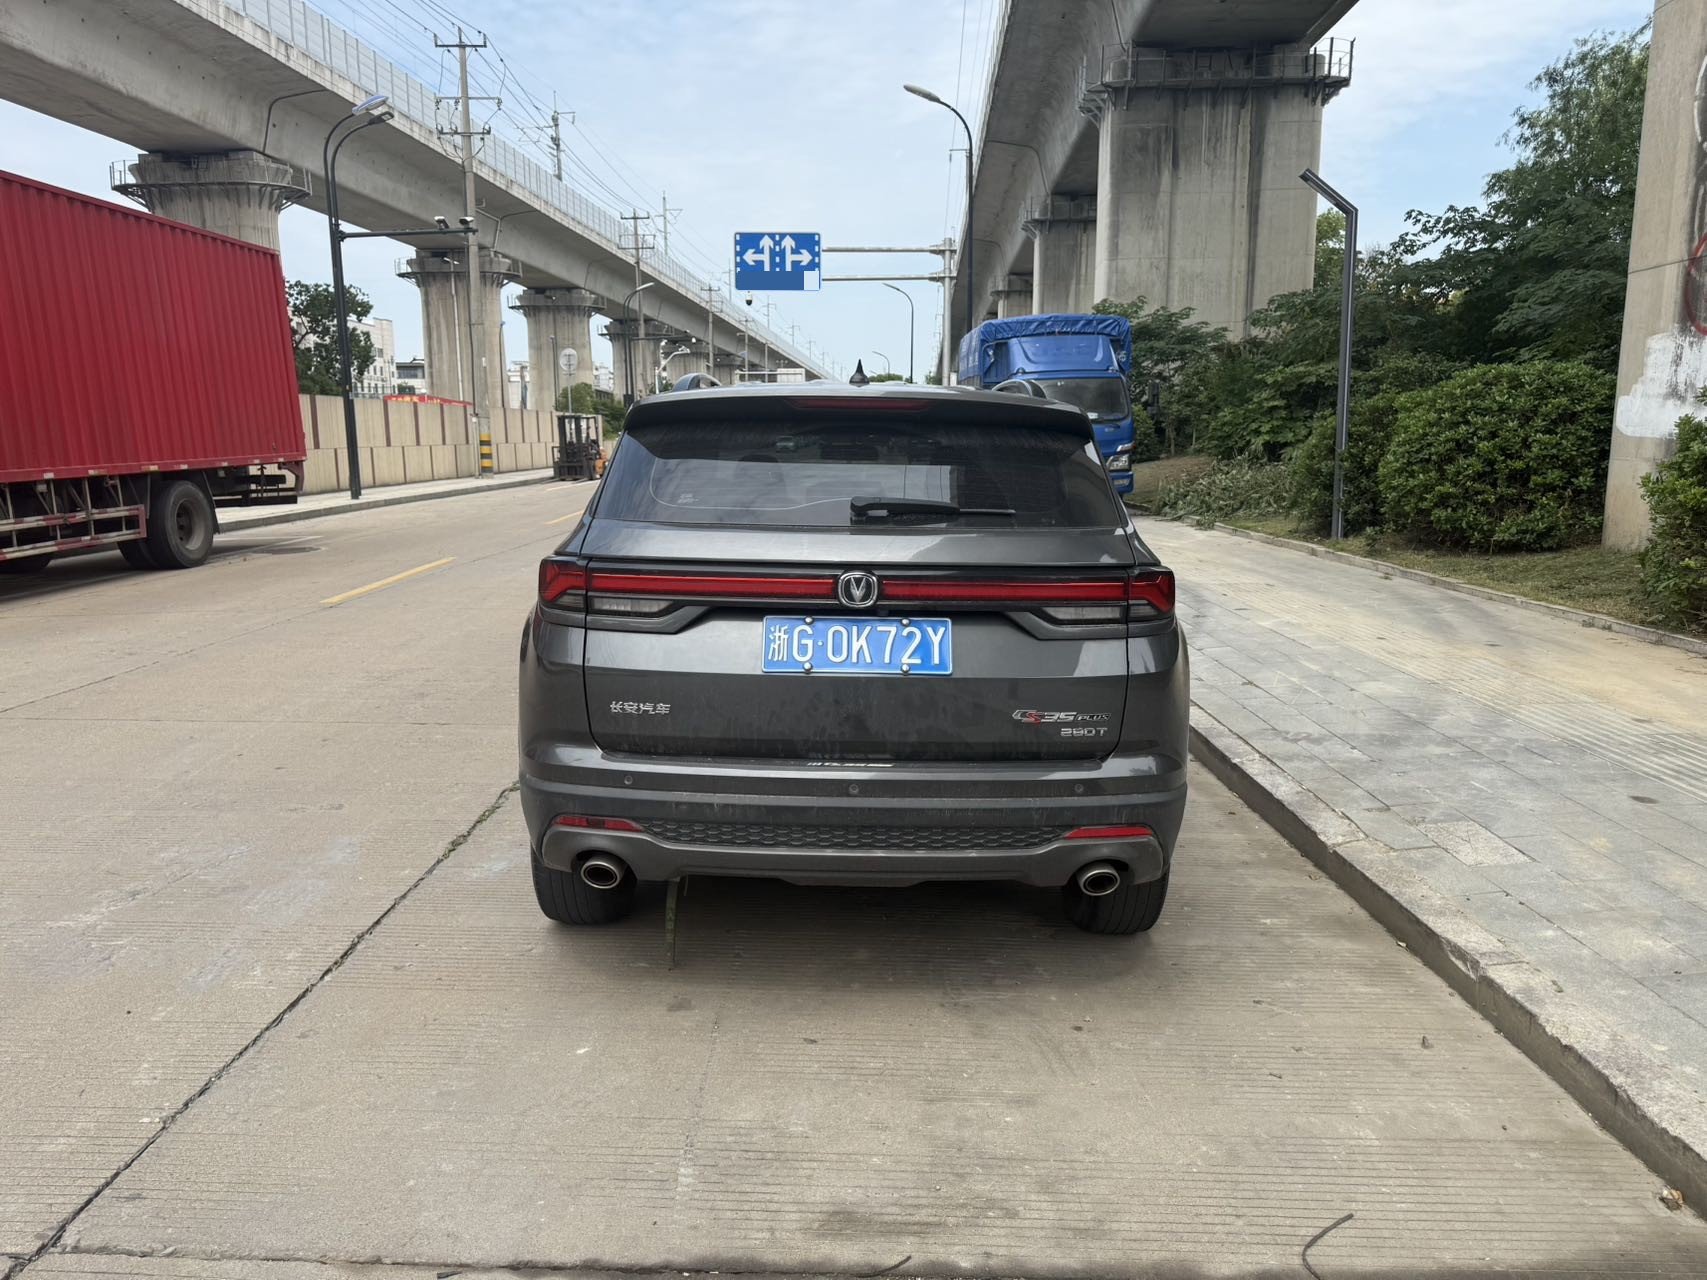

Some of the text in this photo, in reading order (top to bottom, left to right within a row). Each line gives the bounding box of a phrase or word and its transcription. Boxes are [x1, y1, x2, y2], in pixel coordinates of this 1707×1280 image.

[609, 701, 671, 715] 长安汽车
[1060, 727, 1108, 737] 280T
